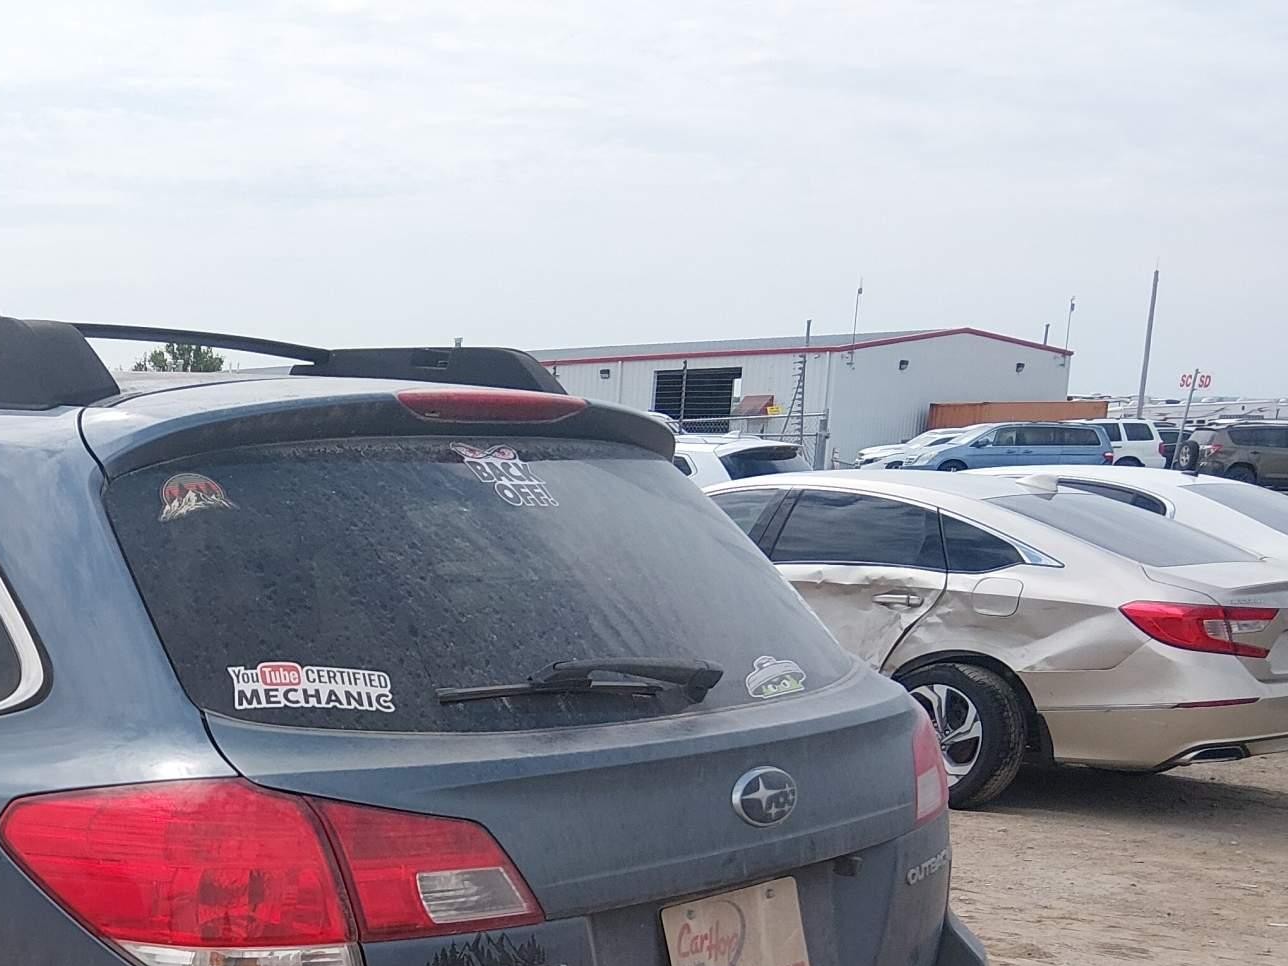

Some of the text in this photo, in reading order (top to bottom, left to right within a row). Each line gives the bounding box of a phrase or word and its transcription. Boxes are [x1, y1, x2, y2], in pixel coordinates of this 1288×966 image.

[1198, 374, 1212, 388] SD
[464, 460, 546, 483] BACK
[495, 481, 560, 507] OFF!
[305, 668, 389, 689] CERTIFIED
[237, 688, 394, 710] MECHANIC
